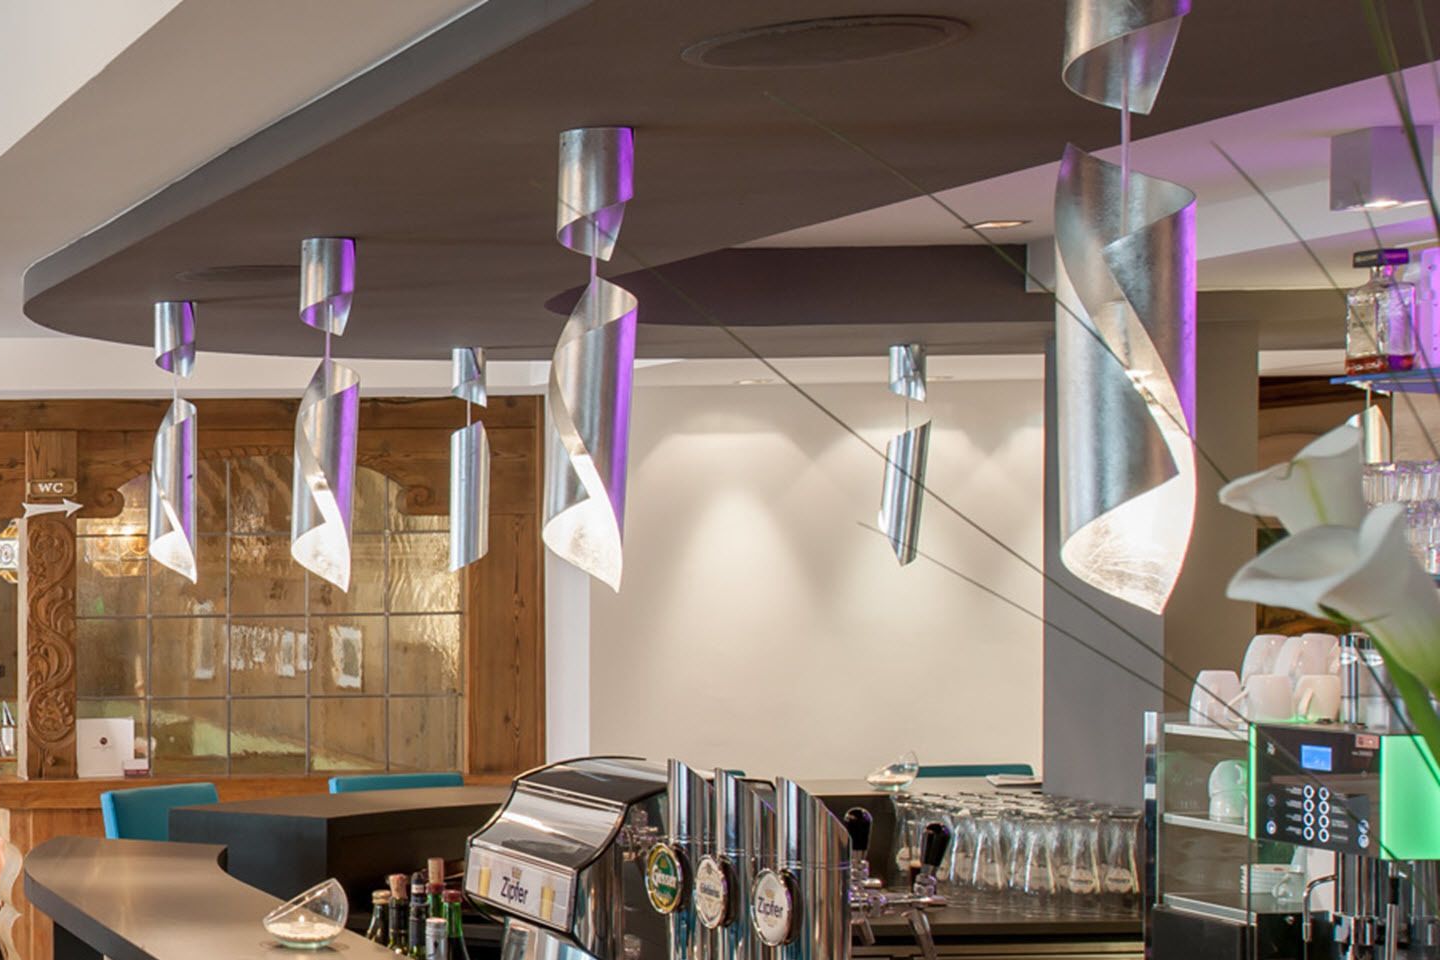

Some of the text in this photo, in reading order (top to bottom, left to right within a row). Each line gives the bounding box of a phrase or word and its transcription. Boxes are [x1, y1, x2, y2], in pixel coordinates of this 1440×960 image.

[38, 482, 63, 493] WC
[501, 876, 528, 904] Zipfer
[757, 896, 783, 918] Zipfer
